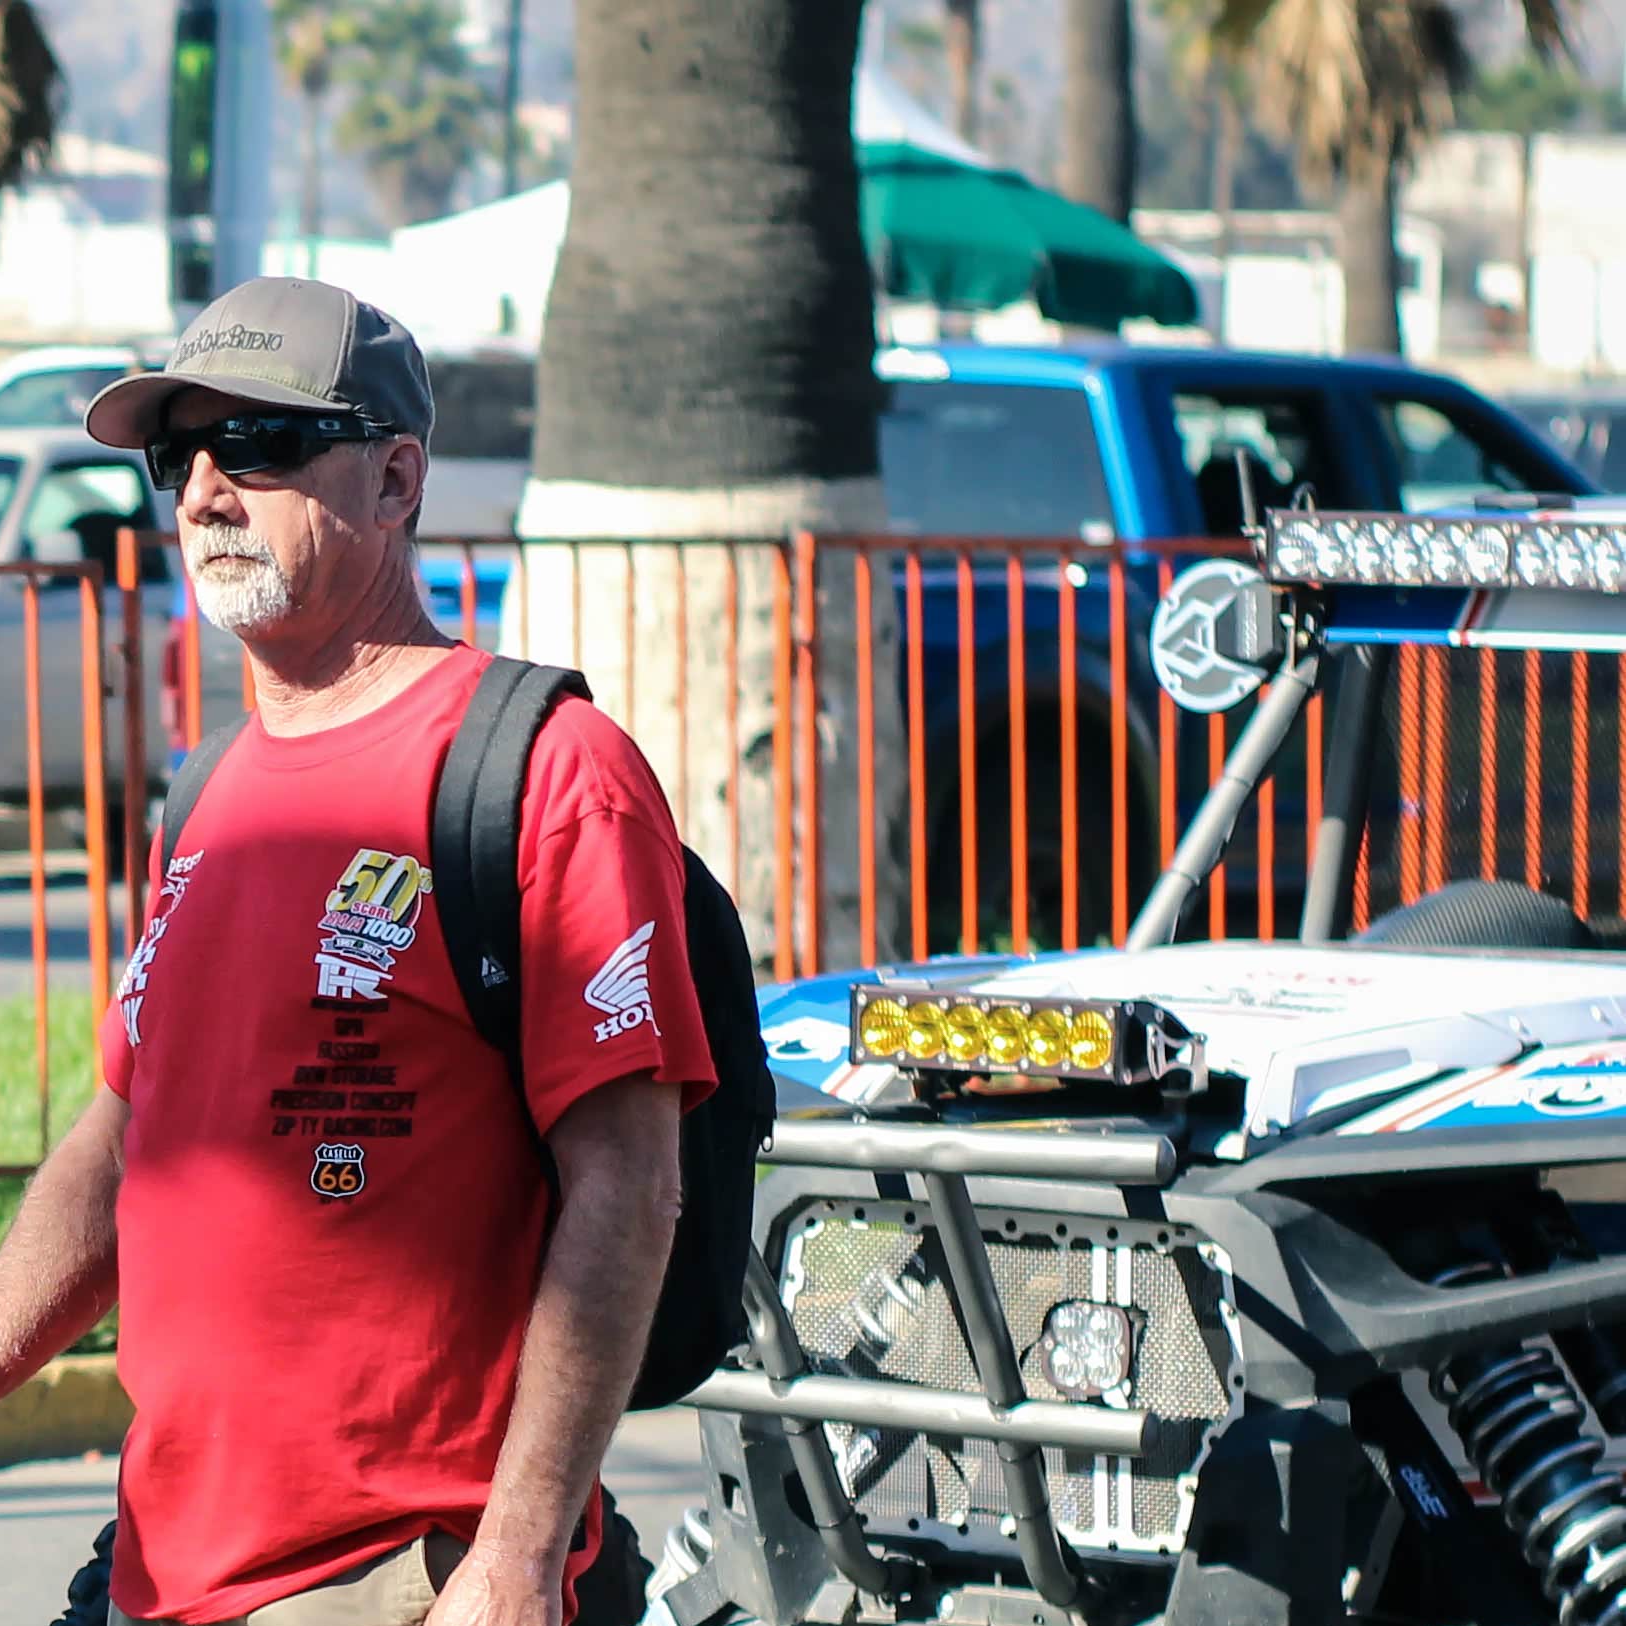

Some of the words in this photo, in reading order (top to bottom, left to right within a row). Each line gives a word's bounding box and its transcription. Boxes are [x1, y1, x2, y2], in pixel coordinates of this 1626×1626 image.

[352, 902, 393, 921] SCORE
[362, 918, 412, 947] 1000
[318, 1164, 357, 1191] 66
